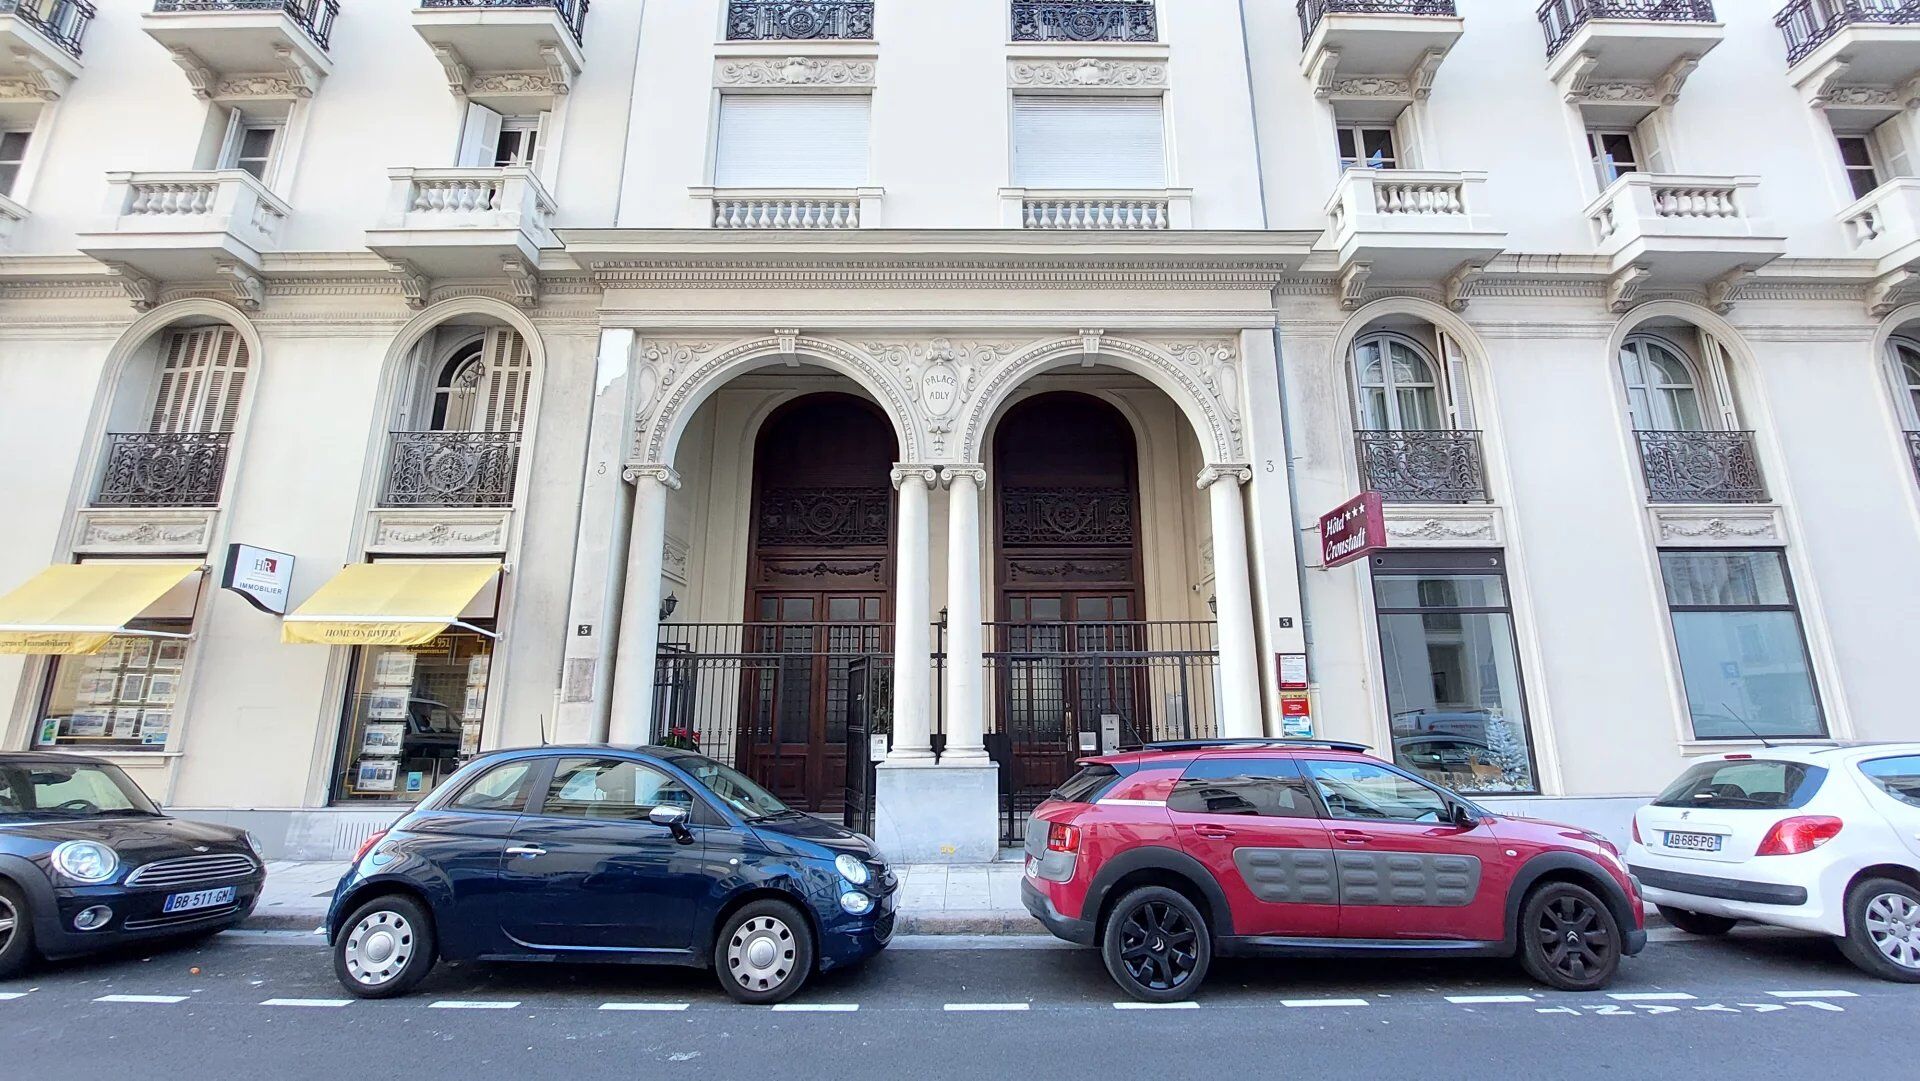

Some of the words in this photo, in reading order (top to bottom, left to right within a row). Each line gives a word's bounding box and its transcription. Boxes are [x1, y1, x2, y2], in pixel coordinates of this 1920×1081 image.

[925, 375, 957, 387] PALACE
[929, 391, 950, 400] ADLY
[597, 462, 606, 475] 3
[1266, 460, 1275, 473] 3
[1325, 512, 1345, 538] Hôtel
[1325, 526, 1366, 561] Cronstadt
[239, 582, 283, 594] IMMOBILIER
[1282, 618, 1290, 627] 3
[580, 625, 589, 635] 3
[437, 637, 450, 648] 951
